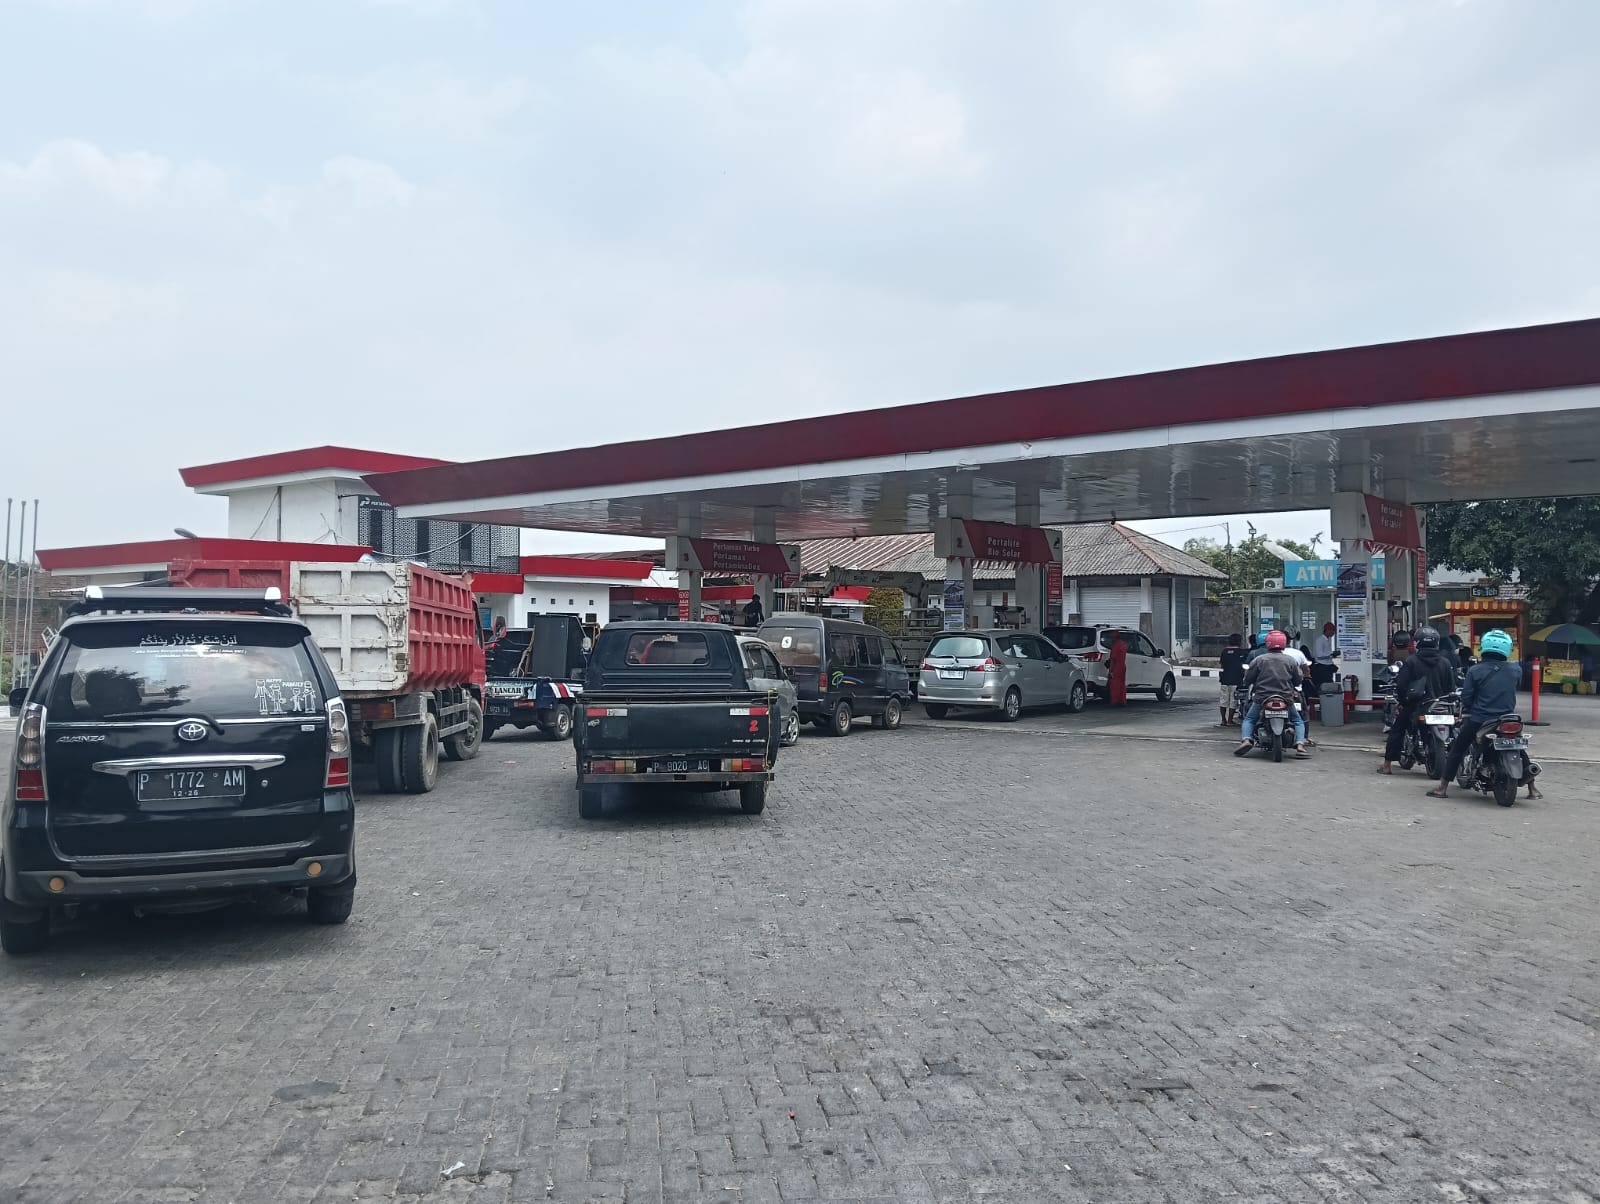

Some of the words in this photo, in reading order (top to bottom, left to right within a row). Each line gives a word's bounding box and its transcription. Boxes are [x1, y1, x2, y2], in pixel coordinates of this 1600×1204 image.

[713, 542, 741, 551] Pertamax
[743, 544, 760, 553] Turbo
[987, 536, 1020, 548] Pertalite
[713, 551, 745, 561] Pertamax
[1296, 566, 1334, 581] ATM
[749, 719, 760, 733] 2
[56, 735, 105, 743] AVANZA
[654, 761, 660, 772] P
[667, 760, 688, 772] 9020
[140, 773, 150, 790] P
[169, 771, 205, 789] 1772
[223, 769, 243, 787] AM
